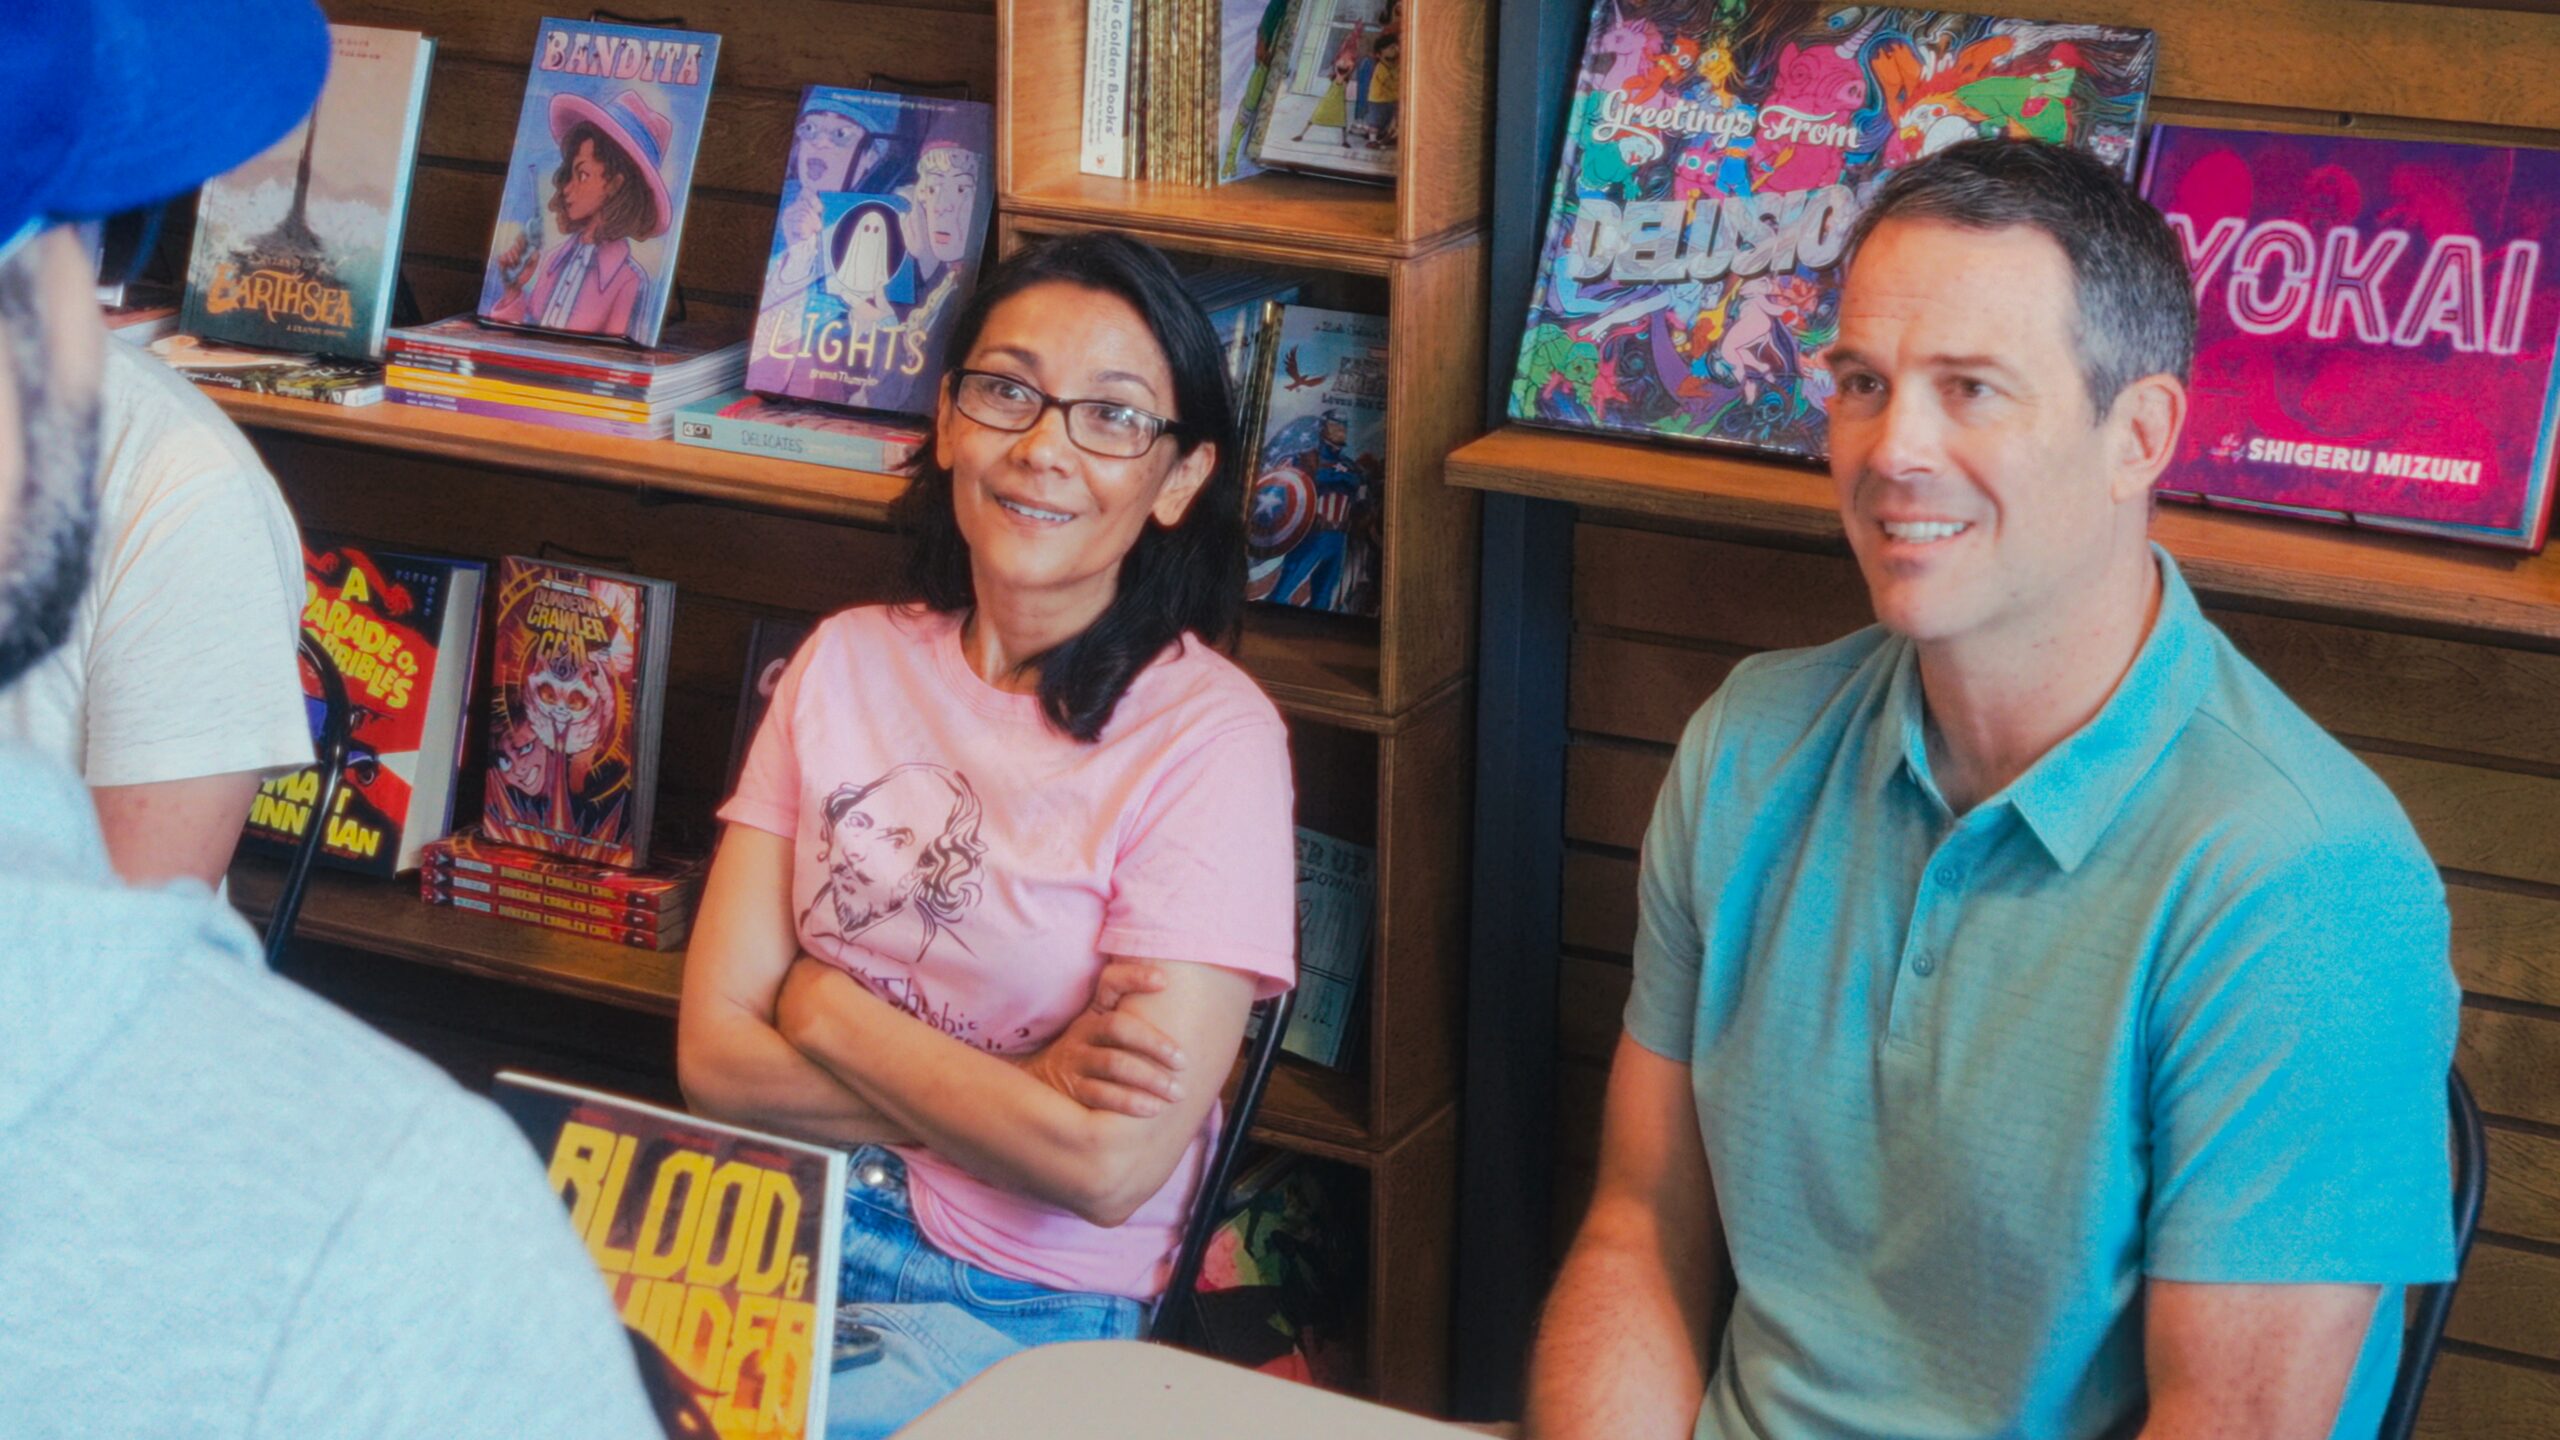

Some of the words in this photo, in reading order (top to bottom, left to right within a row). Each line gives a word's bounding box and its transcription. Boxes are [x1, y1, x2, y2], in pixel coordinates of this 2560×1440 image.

[539, 31, 703, 85] BANDITA
[1107, 19, 1122, 78] Golden
[1104, 83, 1120, 135] Books
[1592, 89, 1753, 160] Greetings
[1758, 104, 1861, 149] From
[1571, 183, 1868, 284] DELUSIO
[206, 262, 354, 328] EARTHSEA
[2164, 213, 2541, 355] YOKAI
[767, 310, 928, 376] LIGHTS
[740, 430, 806, 453] DELICATES
[2247, 438, 2372, 473] SHIGERU
[2373, 452, 2482, 486] MIZUKI
[340, 567, 370, 602] A
[527, 602, 610, 643] CRAWLER
[262, 770, 352, 814] MAT
[540, 1120, 801, 1297] BLOOD
[784, 1254, 809, 1300] &
